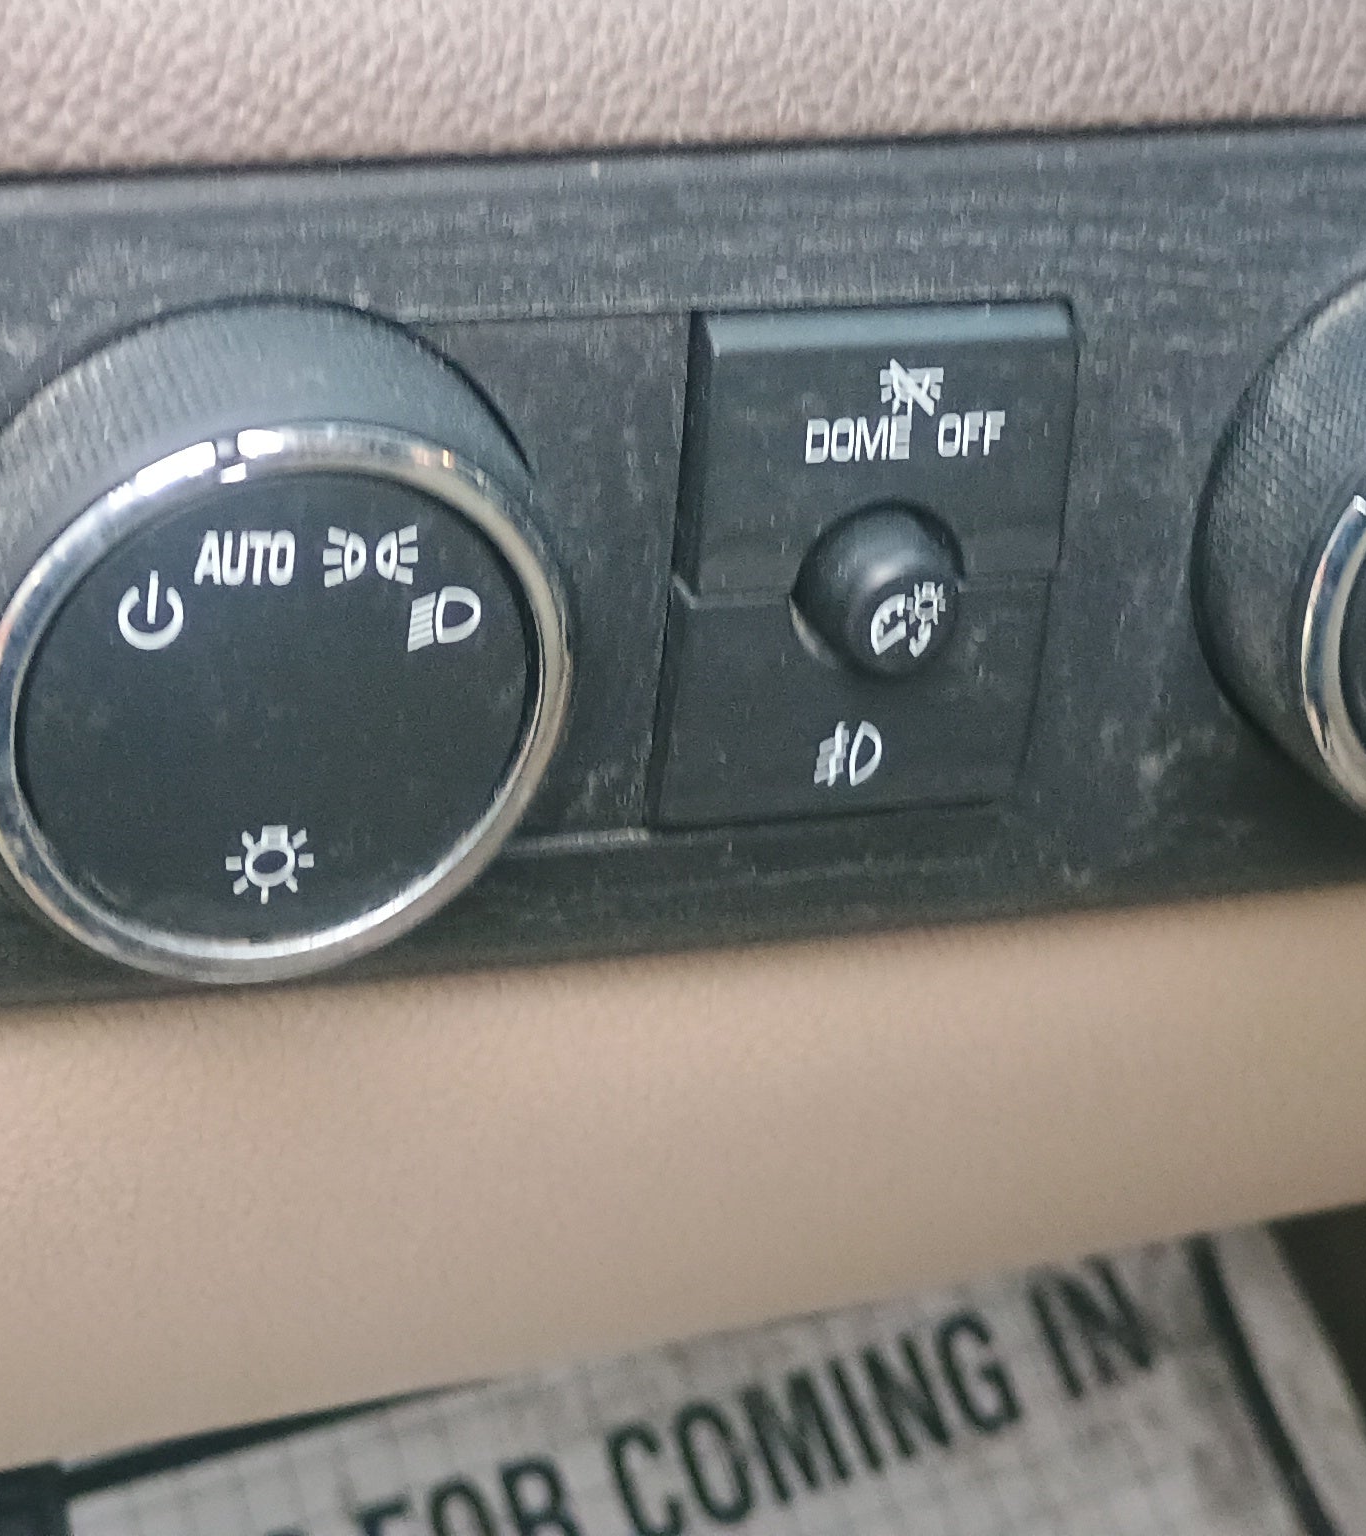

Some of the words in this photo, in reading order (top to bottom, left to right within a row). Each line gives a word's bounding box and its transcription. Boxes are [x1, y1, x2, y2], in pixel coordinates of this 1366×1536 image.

[804, 414, 911, 464] DOME
[937, 410, 1006, 458] OFF
[193, 529, 297, 586] AUTO
[604, 1310, 1023, 1536] COMING
[1029, 1254, 1154, 1400] IN
